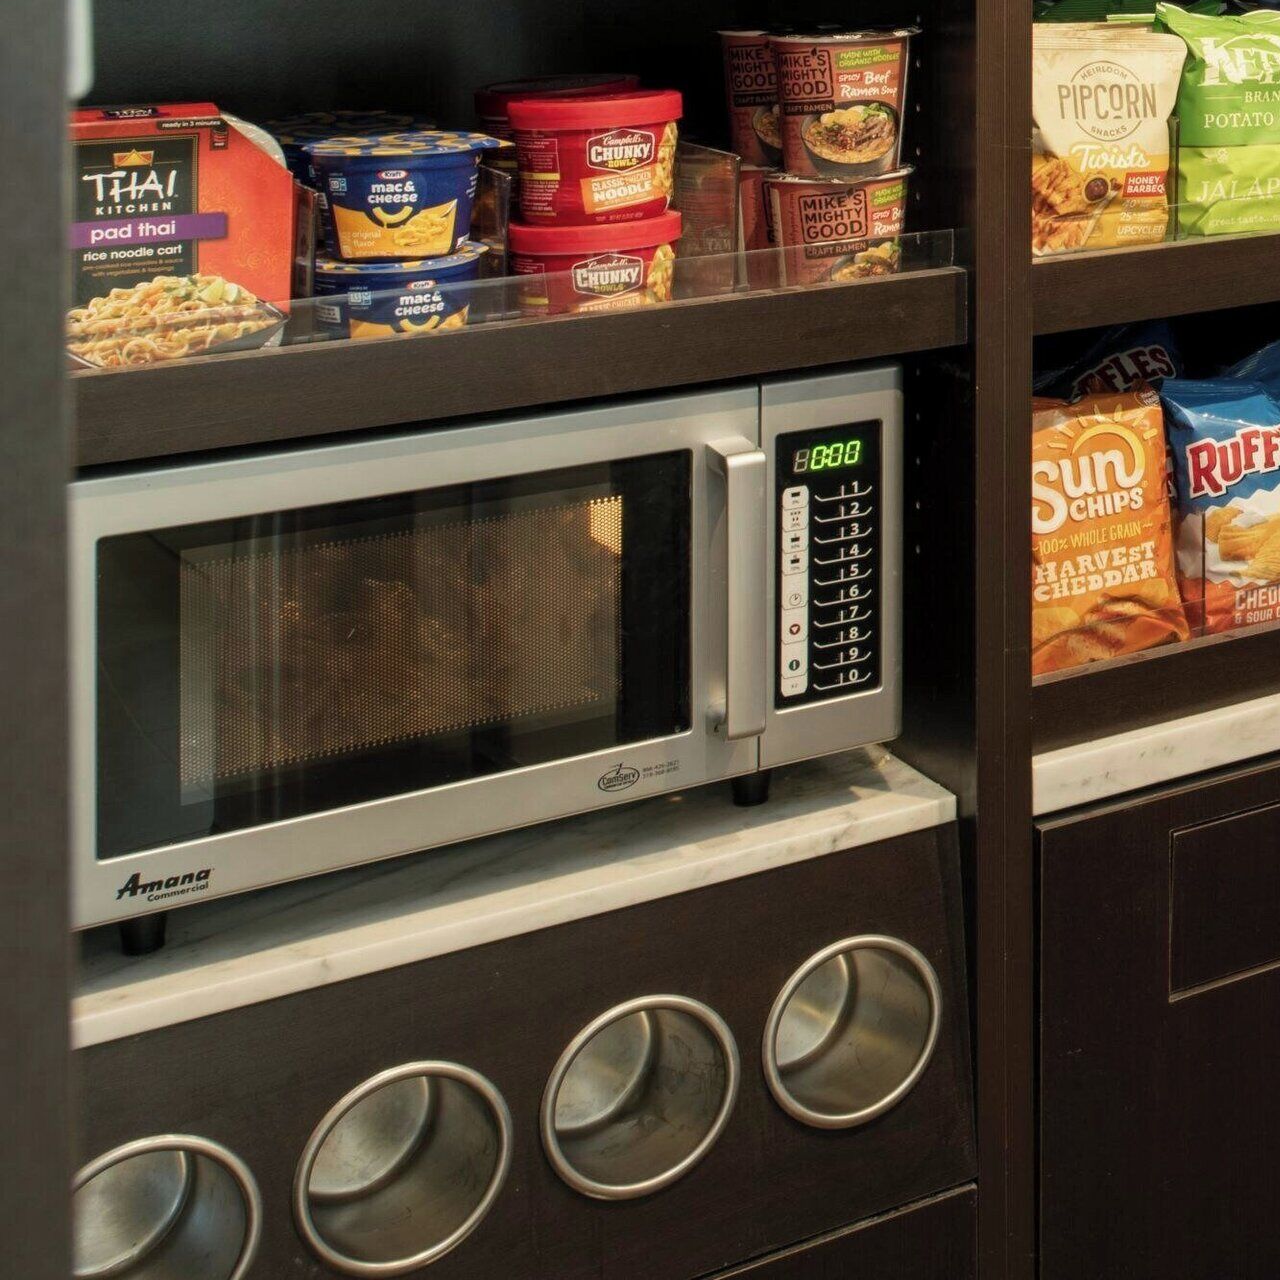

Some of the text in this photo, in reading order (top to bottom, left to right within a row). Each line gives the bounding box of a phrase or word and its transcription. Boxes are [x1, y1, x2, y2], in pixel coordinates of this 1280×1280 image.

[779, 53, 826, 68] MIKE'S
[782, 68, 827, 81] MIGHTY
[865, 70, 890, 85] Beef
[1080, 63, 1128, 81] HEIRLOOM
[840, 85, 879, 98] Ramen
[1058, 83, 1158, 120] PIPCORN
[1204, 112, 1274, 128] POTATO
[1090, 125, 1128, 138] SNACKS
[590, 142, 651, 163] CHUNKY
[1071, 143, 1150, 172] Twists
[607, 159, 637, 168] BOWLS
[82, 170, 178, 203] THAI
[371, 181, 415, 193] mac &
[1128, 176, 1161, 186] HONEY
[593, 182, 651, 203] NOODLE
[96, 202, 172, 215] KITCHEN
[803, 192, 862, 210] MIKE'S
[805, 207, 862, 224] MIGHTY
[91, 221, 176, 243] pad thai
[1117, 224, 1165, 234] UPCYCLED
[83, 245, 182, 262] rice noodle cart
[836, 242, 866, 253] RAMEN
[576, 267, 639, 288] CHUNKY
[400, 291, 442, 305] mac &
[851, 481, 859, 493] 1
[1033, 450, 1128, 534] Sun
[850, 502, 859, 515] 2
[1070, 488, 1144, 522] CHIPS
[850, 523, 859, 535] 3
[1070, 524, 1141, 549] WHOLE GRAIN
[850, 544, 859, 556] 4
[1035, 541, 1156, 583] HARVEST
[850, 564, 859, 577] 5
[1033, 560, 1158, 603] CHEDDAR
[850, 585, 859, 597] 6
[850, 606, 859, 619] 7
[1247, 609, 1273, 624] SOUR
[849, 626, 859, 639] 8
[849, 647, 859, 660] 9
[849, 669, 858, 682] 0
[116, 867, 212, 900] Amana
[146, 881, 210, 904] Commercial
